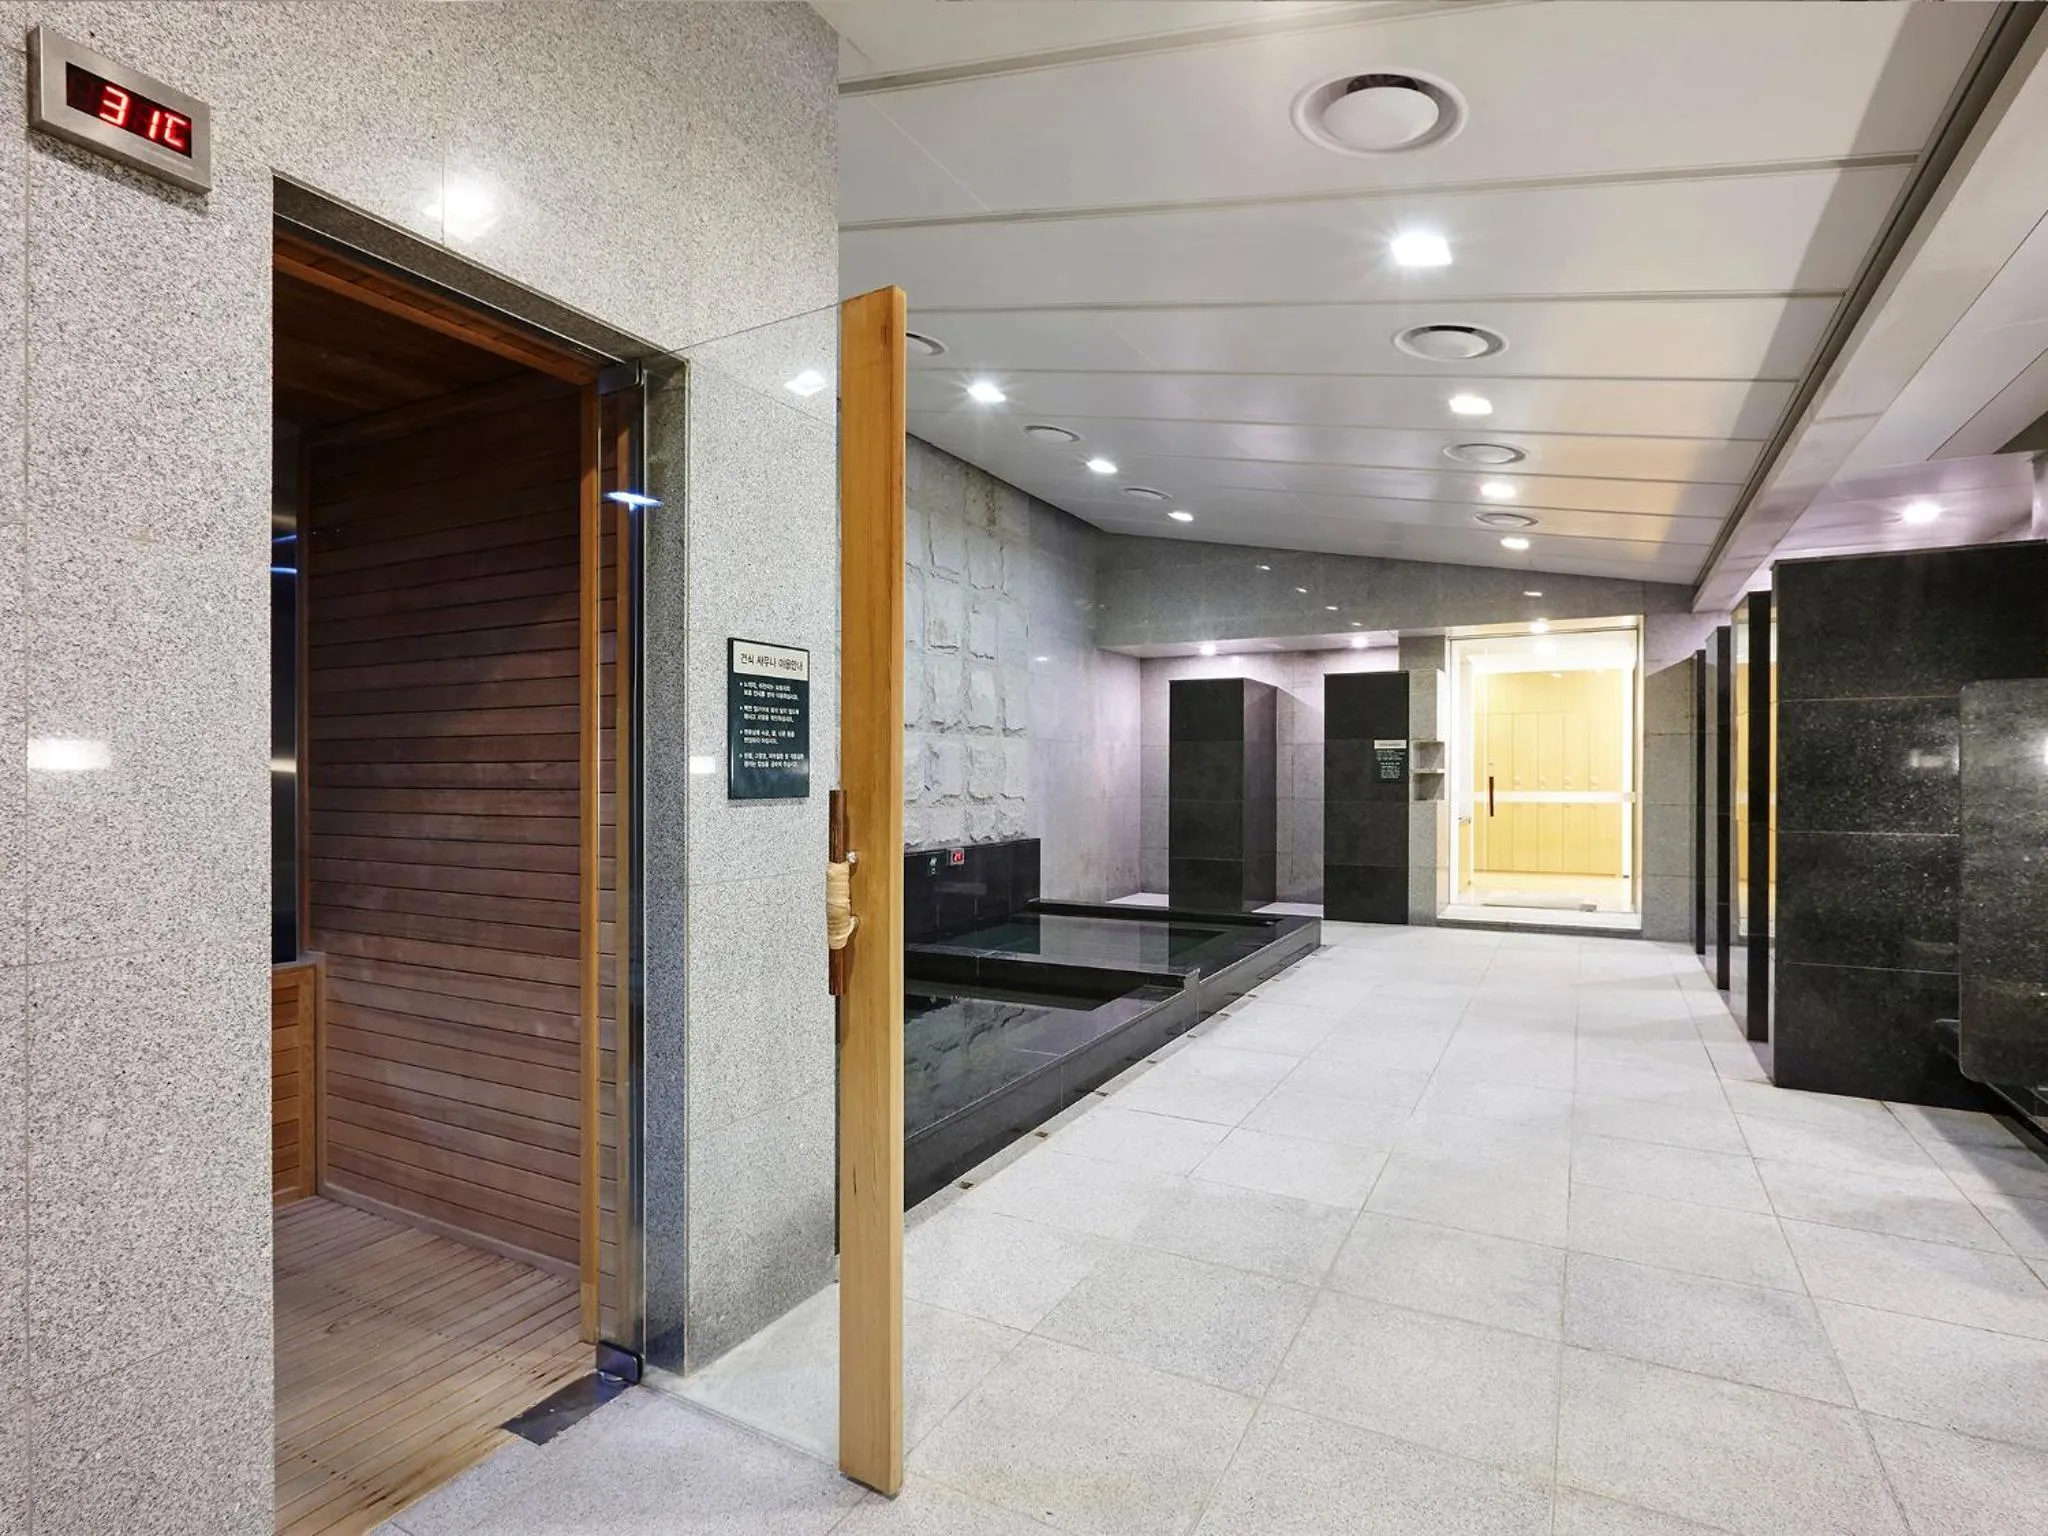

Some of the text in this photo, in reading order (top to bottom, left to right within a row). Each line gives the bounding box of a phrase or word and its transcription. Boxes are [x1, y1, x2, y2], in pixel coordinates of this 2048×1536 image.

[740, 653, 803, 672] 건식 사우나 이용안내
